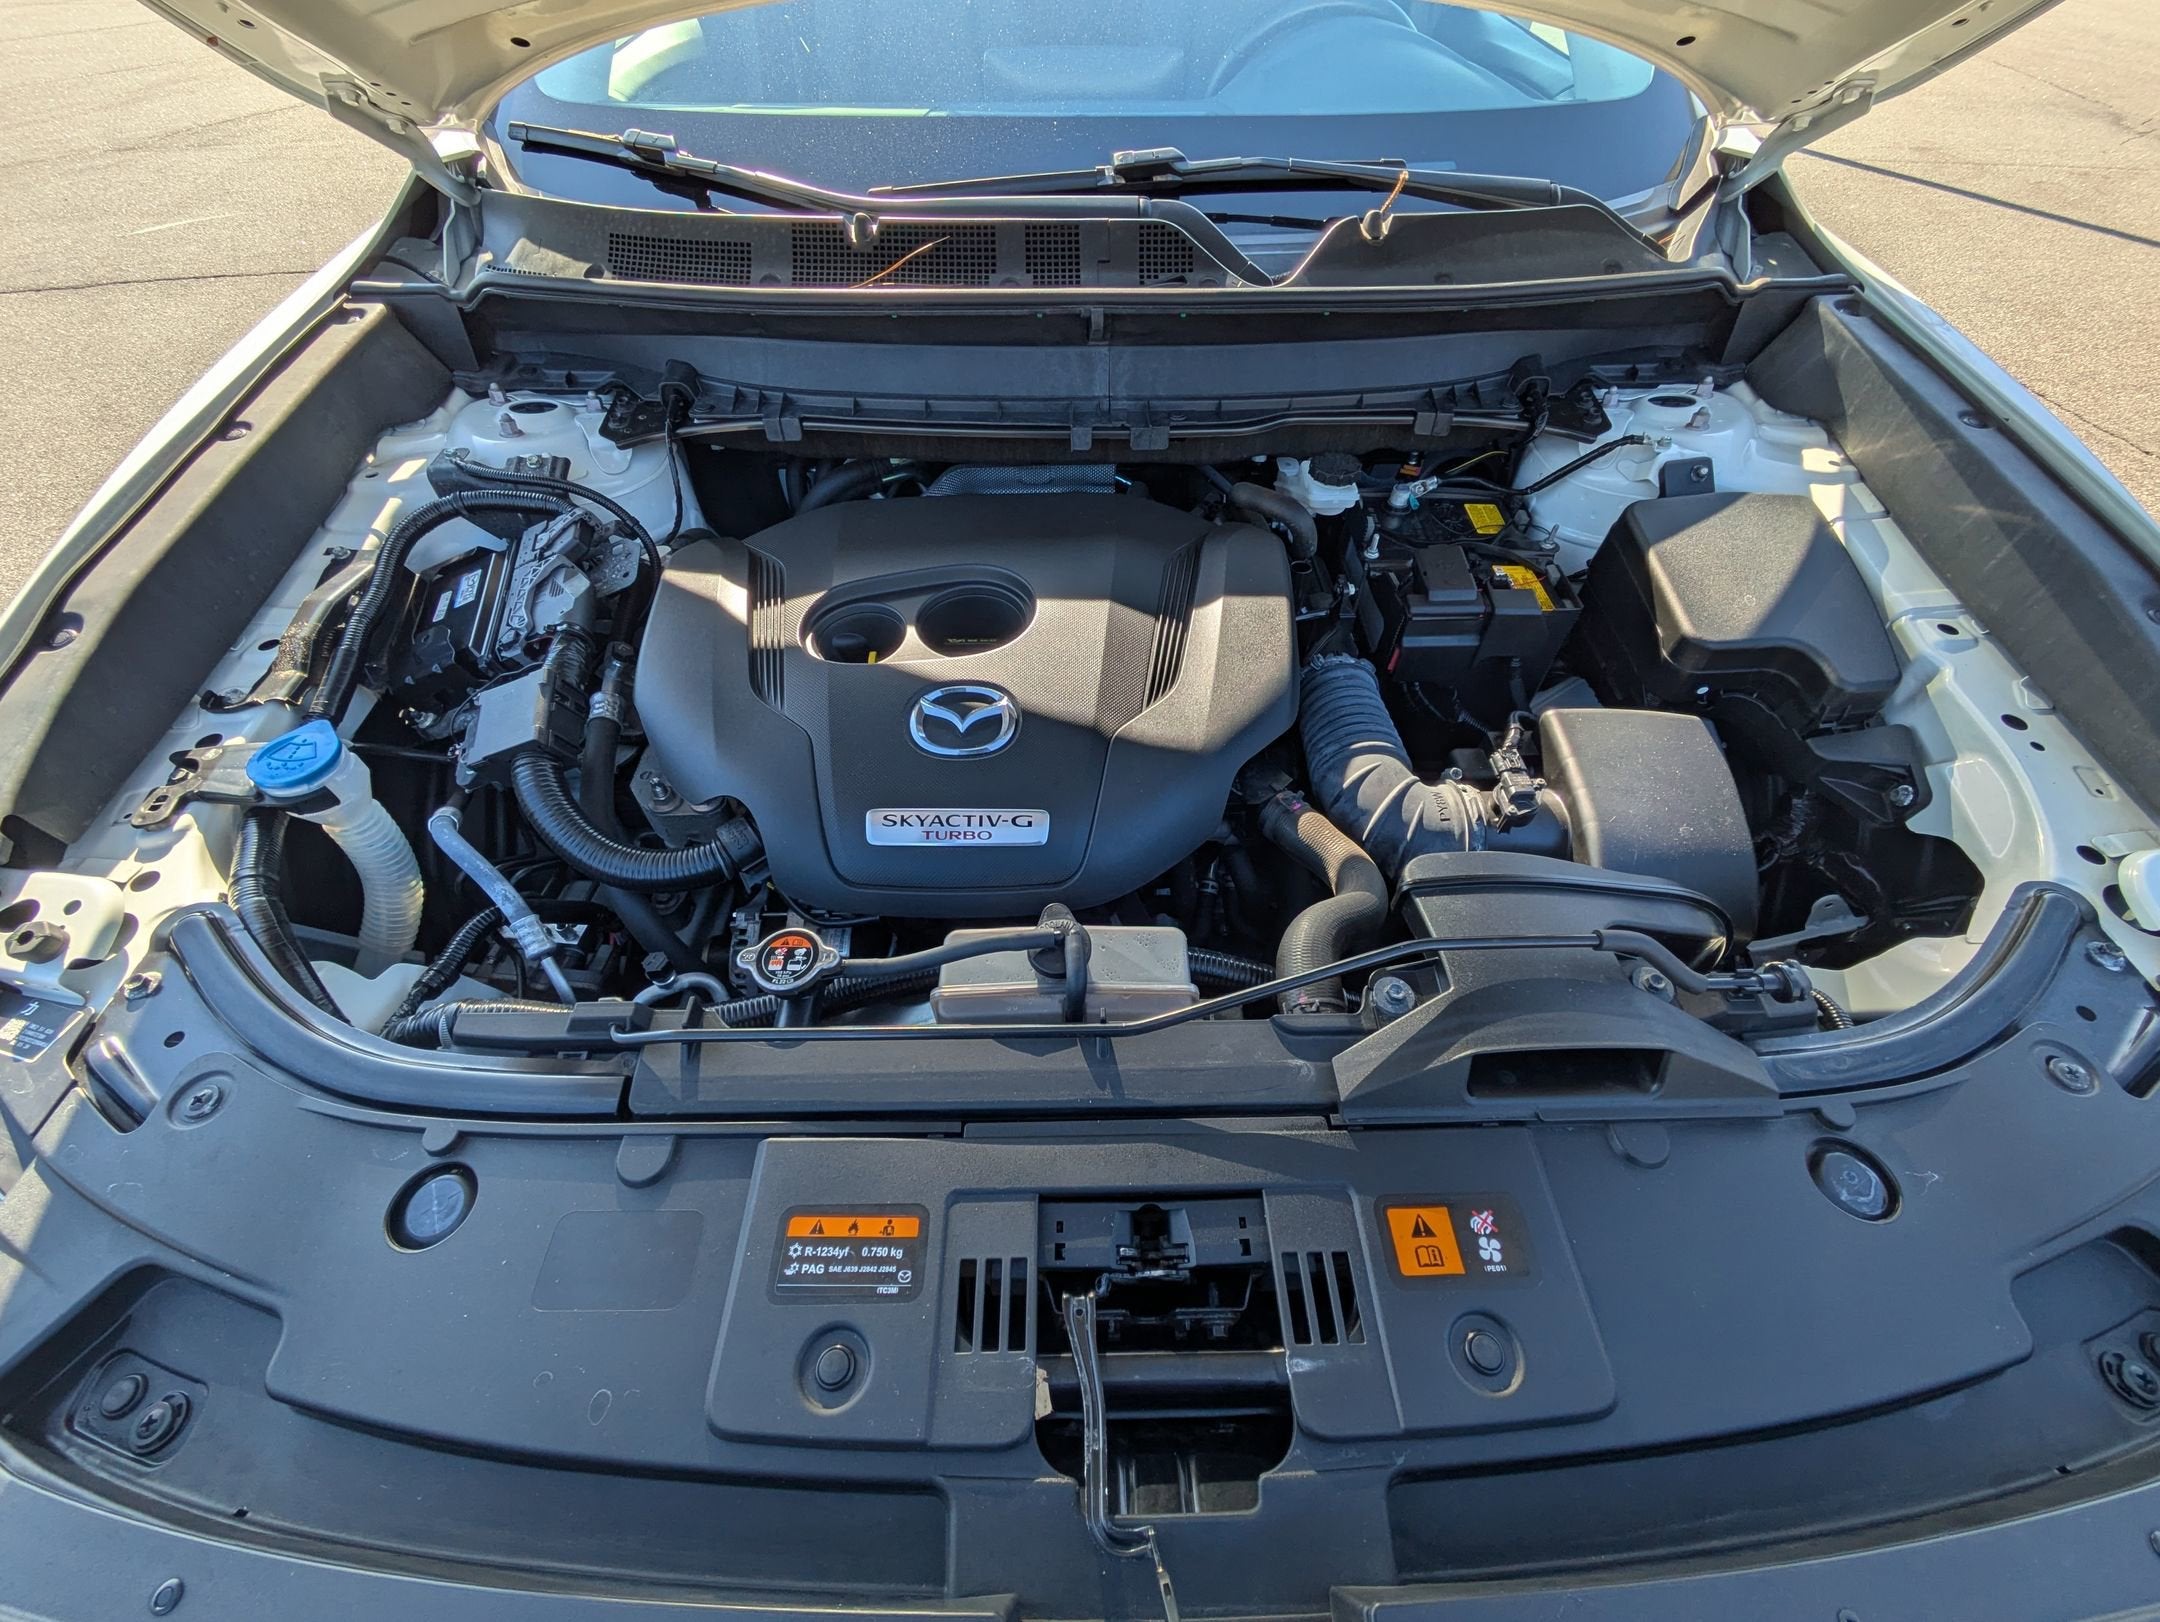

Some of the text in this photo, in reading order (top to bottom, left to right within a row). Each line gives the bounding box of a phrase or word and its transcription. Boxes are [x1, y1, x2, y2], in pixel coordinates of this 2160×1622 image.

[881, 814, 1033, 828] SKYACTIV-G
[921, 830, 993, 841] TURBO
[804, 1246, 904, 1260] R-1234yf 0.750 kg
[801, 1263, 825, 1275] PAG
[828, 1265, 843, 1273] SAE
